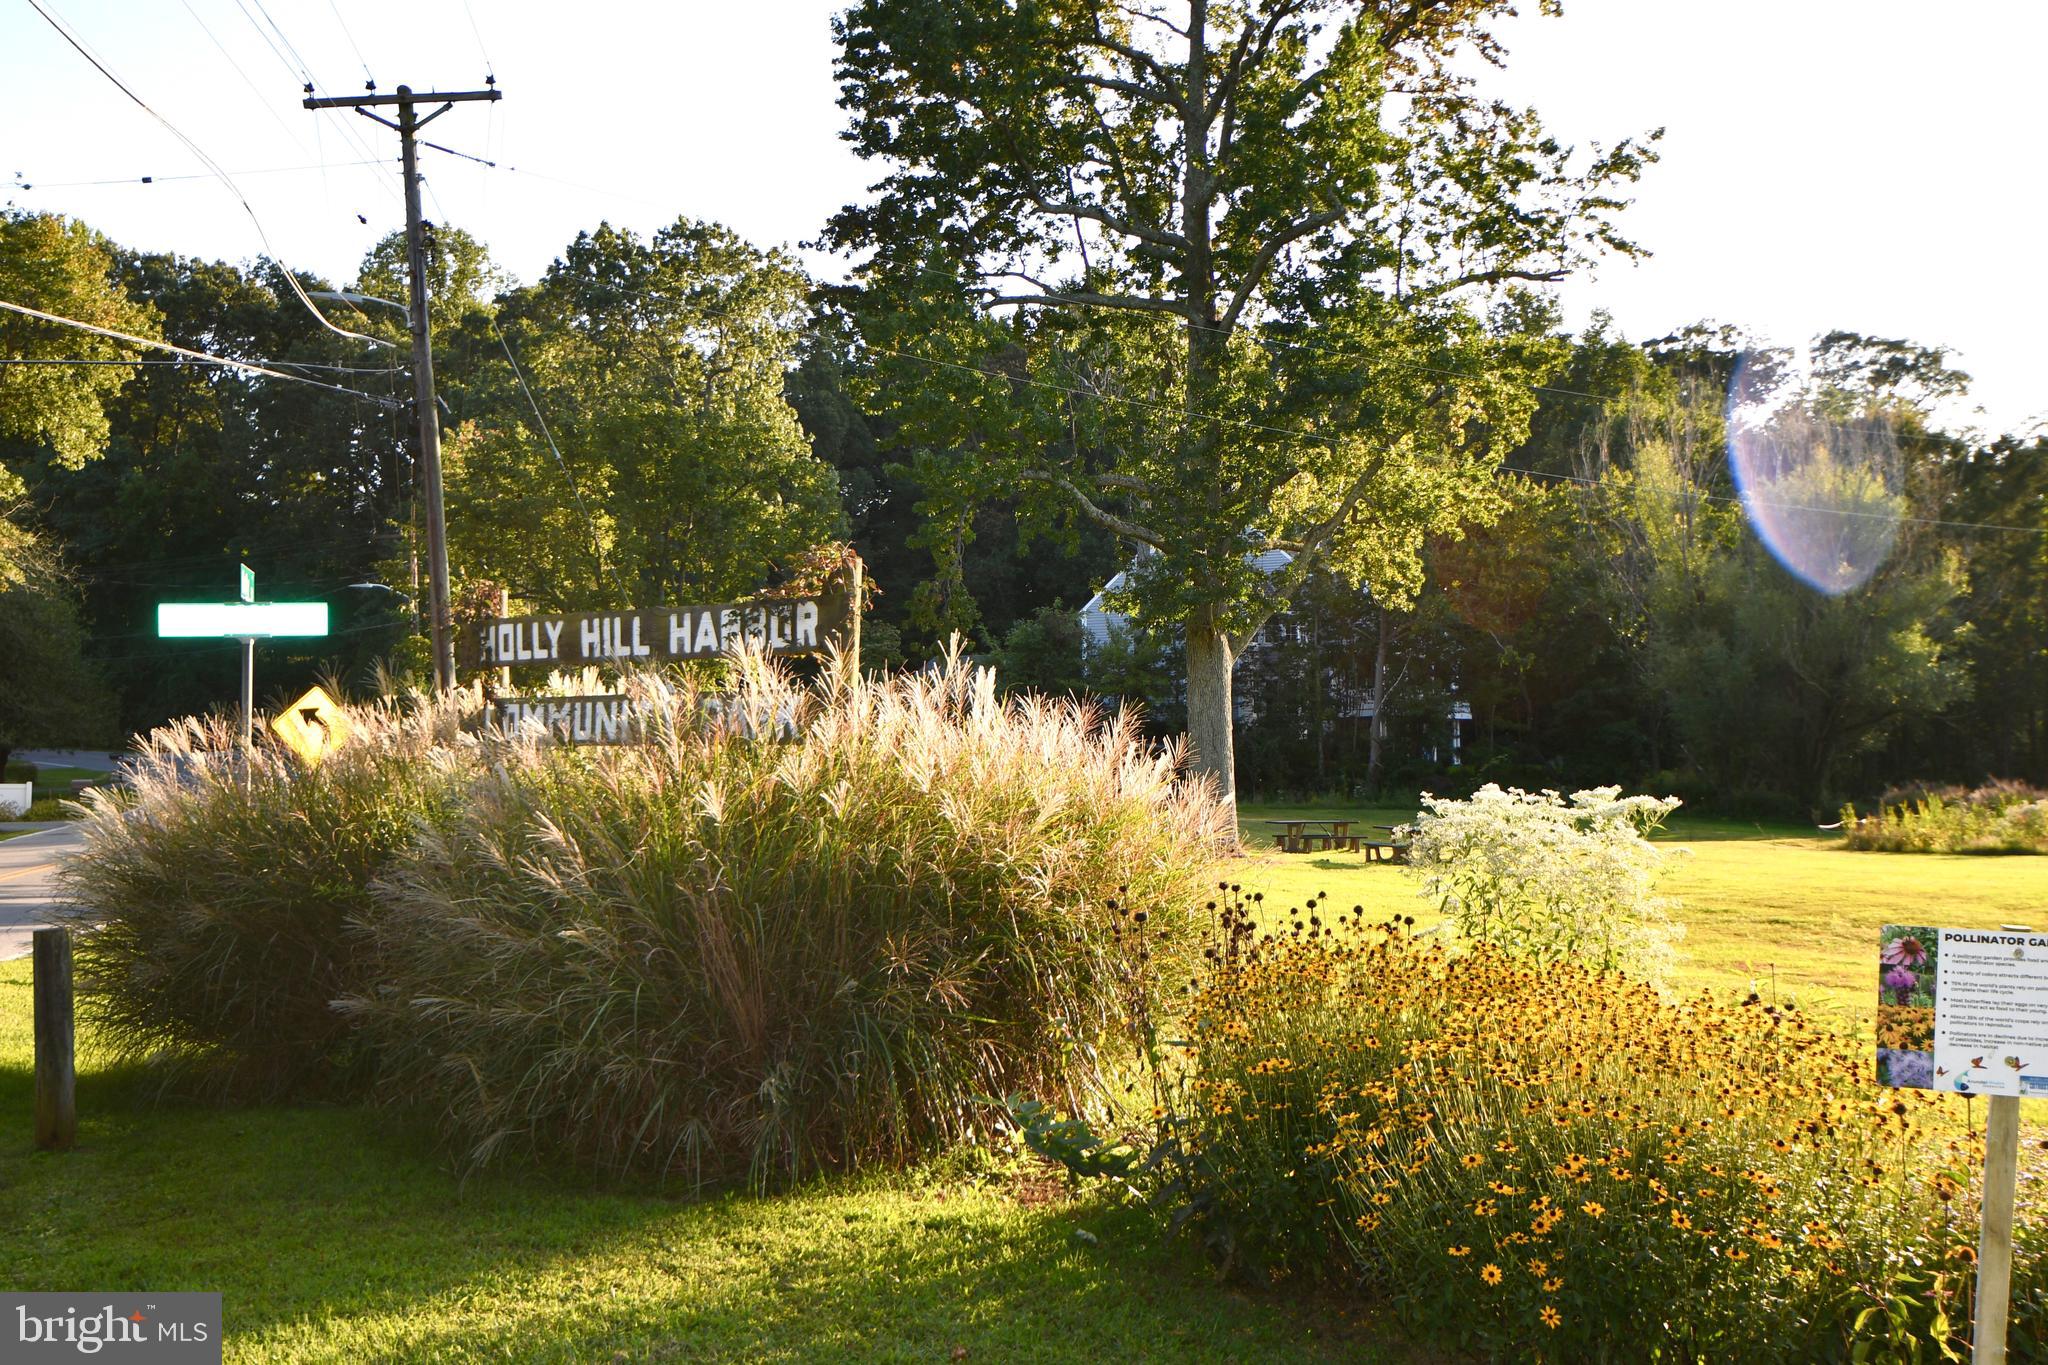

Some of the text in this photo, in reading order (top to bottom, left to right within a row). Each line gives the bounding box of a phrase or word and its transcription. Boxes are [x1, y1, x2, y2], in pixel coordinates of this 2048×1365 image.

[480, 620, 564, 662] HOLLY
[580, 616, 650, 659] HILL
[1945, 934, 2024, 946] POLLINATOR
